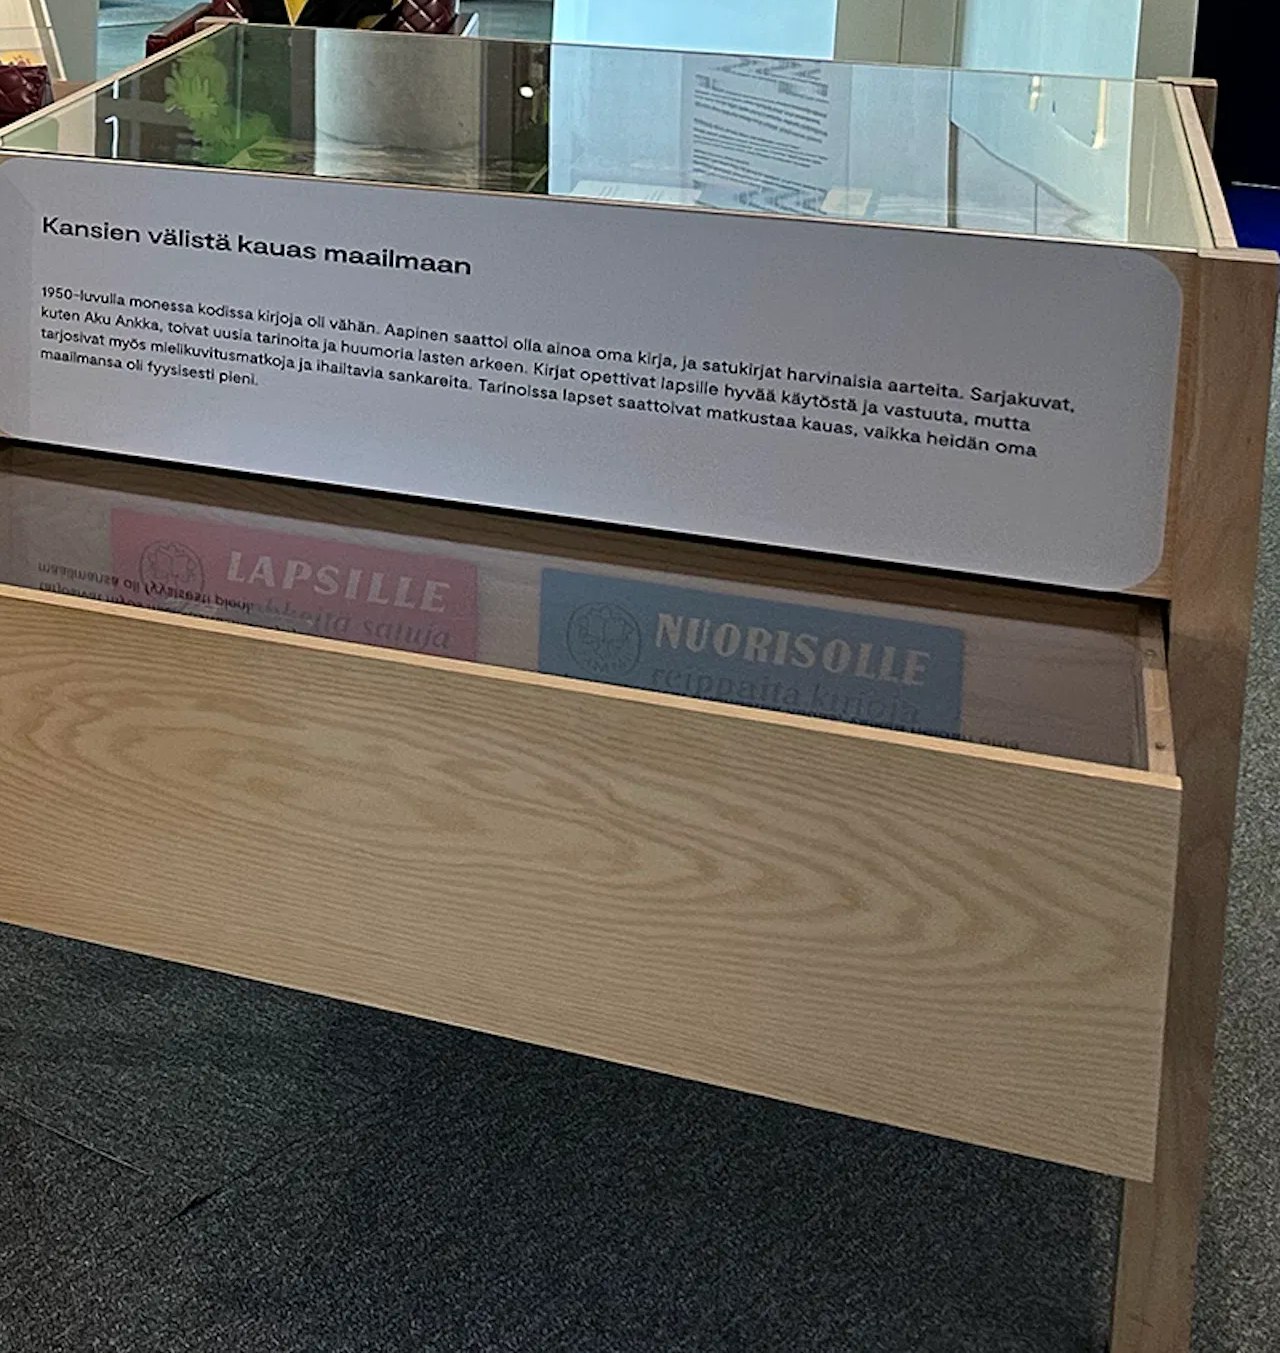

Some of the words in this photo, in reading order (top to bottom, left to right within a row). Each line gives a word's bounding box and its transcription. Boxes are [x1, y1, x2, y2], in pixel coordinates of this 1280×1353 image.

[43, 216, 140, 243] Kansien
[147, 228, 233, 252] välistä
[238, 234, 317, 260] kauas
[324, 247, 471, 275] maailmaan
[40, 349, 123, 369] maailmansa
[126, 358, 143, 371] oli
[147, 360, 215, 381] fyysisesti
[219, 370, 258, 386] pieni.
[41, 305, 80, 322] kuten
[84, 311, 111, 326] Aku
[115, 314, 163, 333] Ankka,
[167, 321, 209, 338] toivat
[213, 328, 252, 342] uusia
[256, 331, 320, 350] tarinoita
[321, 338, 338, 354] ja
[341, 339, 415, 362] huumoria
[418, 348, 465, 367] lasten
[469, 356, 528, 374] arkeen.
[533, 362, 576, 381] Kirjat
[580, 370, 657, 389] opettivat
[660, 376, 719, 396] lapsille
[724, 383, 777, 403] hyvää
[781, 389, 858, 413] käytöstä
[862, 399, 879, 416] ja
[884, 404, 968, 426] vastuuta,
[974, 415, 1031, 432] mutta
[42, 286, 126, 307] 1950-luvulla
[129, 297, 194, 314] monessa
[198, 302, 254, 321] kodissa
[257, 308, 303, 328] kirjoja
[307, 315, 325, 329] oli
[329, 318, 380, 335] vähän.
[384, 323, 449, 343] Aapinen
[454, 333, 508, 349] saattoi
[513, 337, 543, 354] olla
[546, 341, 592, 359] ainoa
[596, 349, 633, 363] oma
[637, 350, 677, 370] kirja,
[680, 355, 698, 373] ja
[702, 360, 782, 381] satukirjat
[787, 366, 883, 391] harvinaisia
[887, 381, 964, 400] aarteita.
[970, 386, 1075, 414] Sarjakuvat,
[41, 328, 105, 346] tarjosivat
[108, 337, 146, 352] myös
[150, 341, 295, 371] mielikuvitusmatkoja
[297, 357, 313, 373] ja
[316, 358, 384, 380] ihailtavia
[388, 370, 473, 390] sankareita.
[478, 378, 558, 401] Tarinoissa
[563, 387, 613, 408] lapset
[617, 397, 702, 418] saattoivat
[706, 408, 797, 429] matkustaa
[802, 415, 858, 438] kauas,
[863, 426, 921, 444] vaikka
[926, 430, 989, 452] heidän
[995, 442, 1037, 458] oma
[226, 551, 452, 613] LAPSILLE
[654, 613, 930, 687] NUORISOLLE
